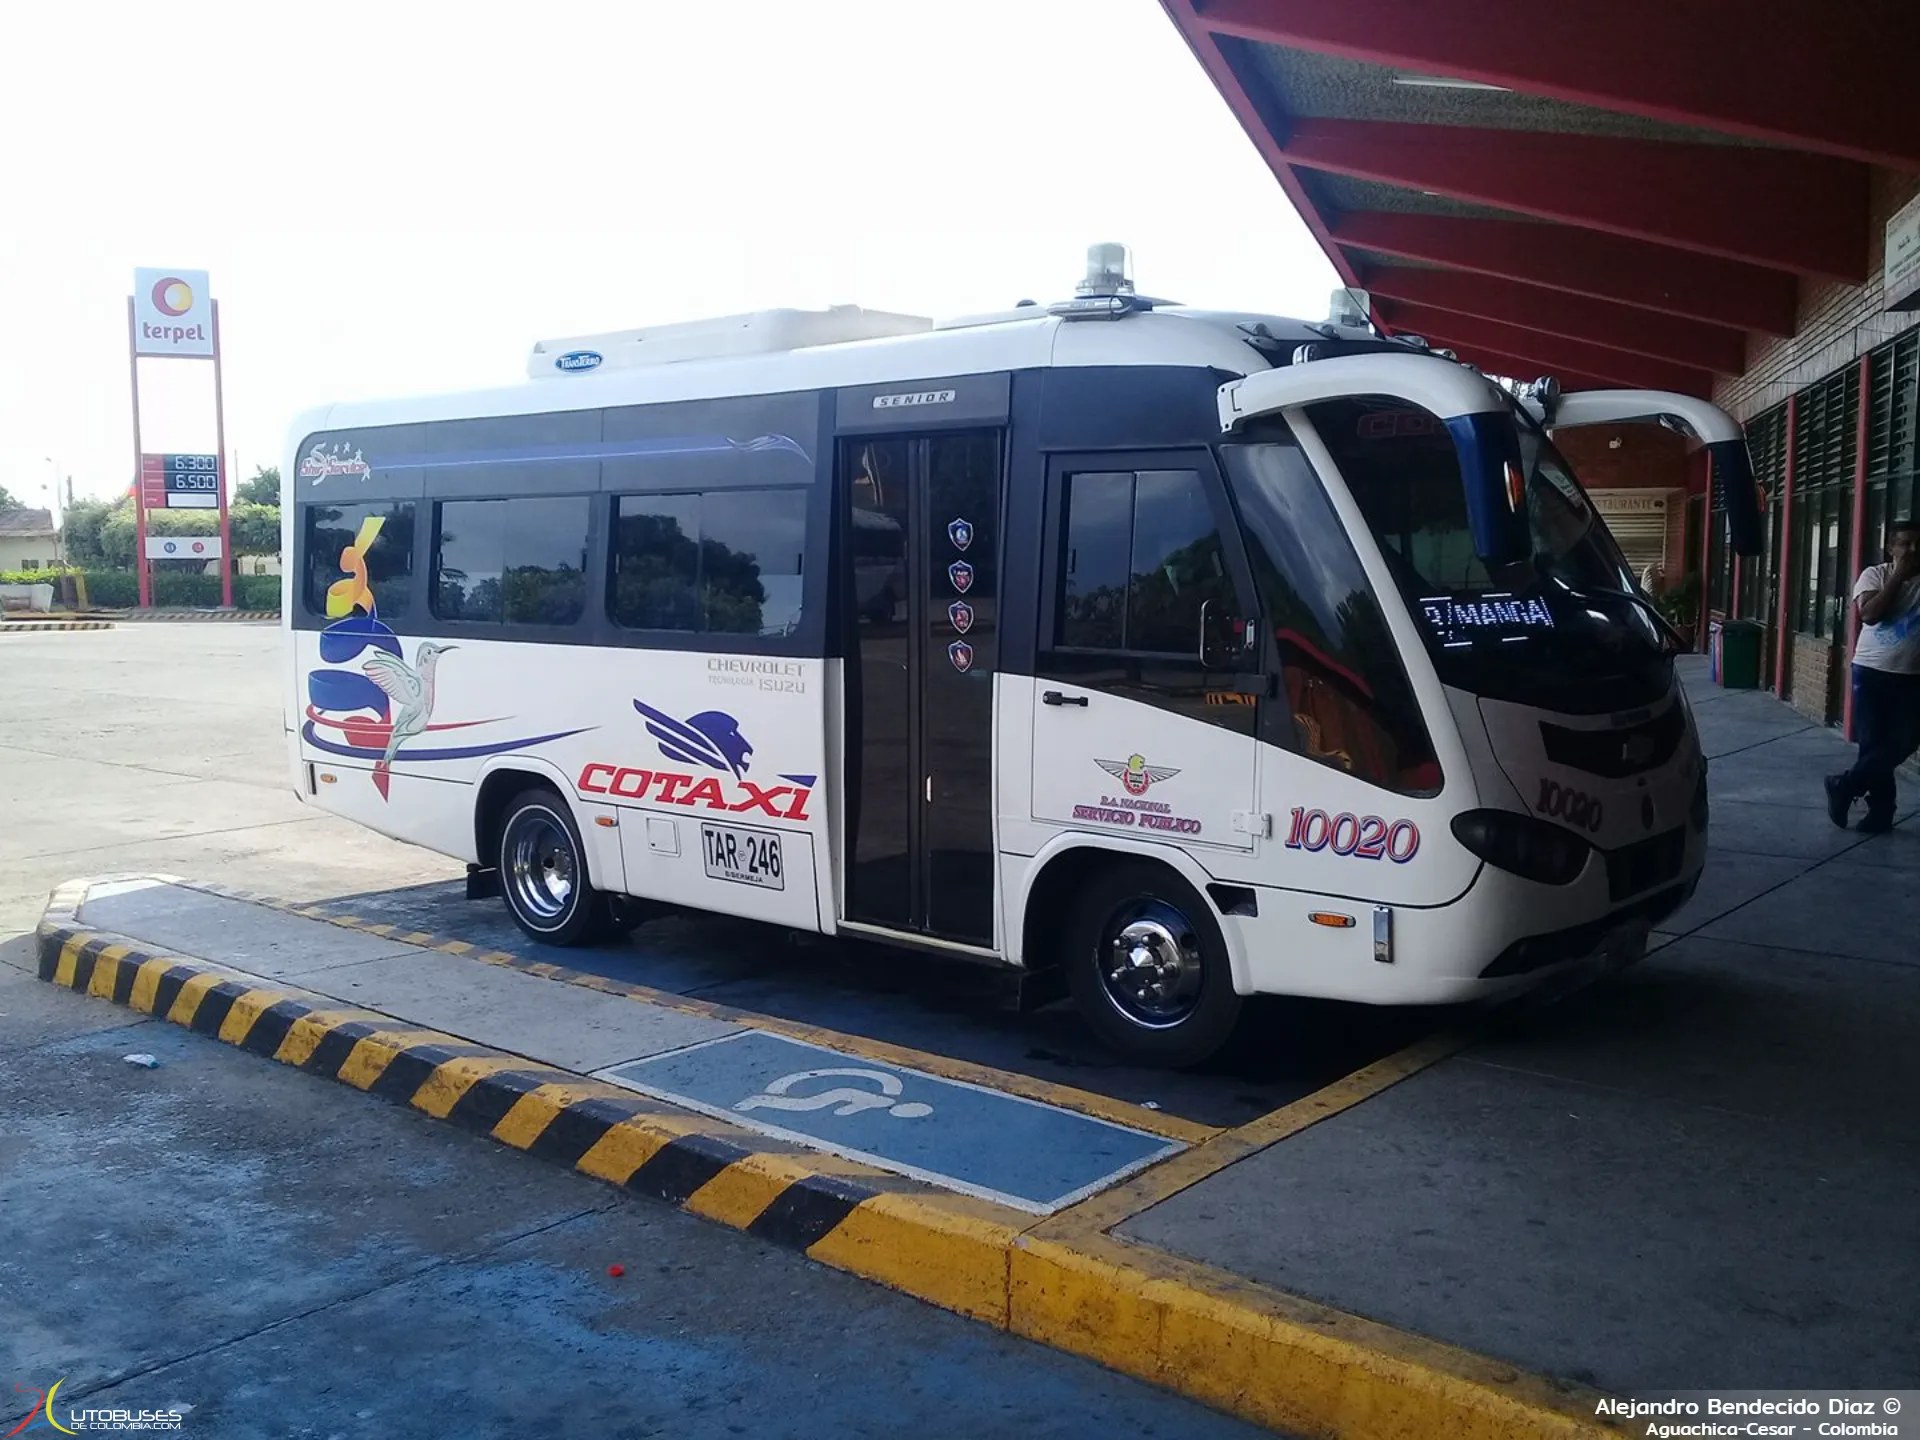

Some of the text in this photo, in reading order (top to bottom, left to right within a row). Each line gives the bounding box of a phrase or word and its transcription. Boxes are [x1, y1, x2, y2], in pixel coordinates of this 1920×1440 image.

[143, 321, 205, 344] terpel
[879, 392, 949, 406] SENIOR
[175, 456, 215, 470] 6.300
[175, 474, 217, 489] 6.500
[707, 658, 803, 676] CHEVROLET
[760, 679, 805, 694] ISUZU
[577, 762, 812, 821] COTAXI
[1120, 798, 1172, 815] NACIONAL
[1536, 777, 1603, 833] 10020
[1072, 804, 1202, 835] SERVICIO PUBLICO
[1285, 806, 1421, 864] 10020
[704, 829, 781, 878] TAR 246
